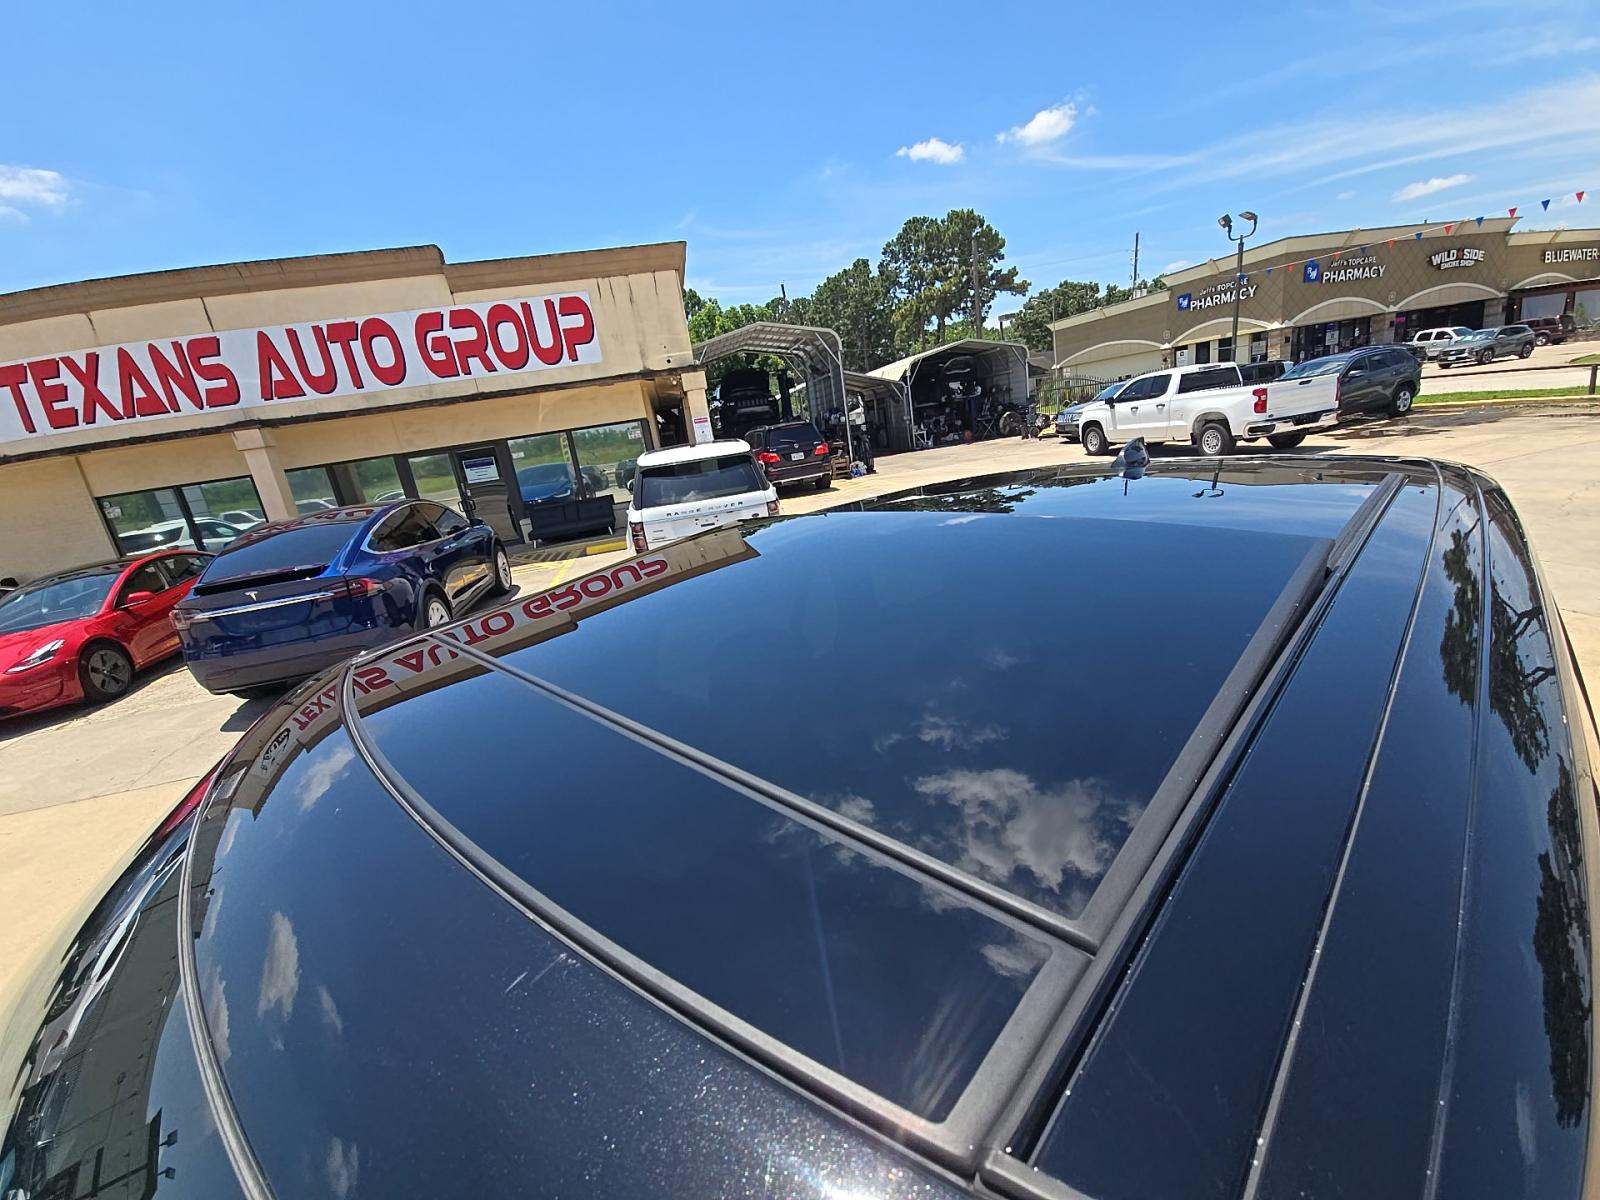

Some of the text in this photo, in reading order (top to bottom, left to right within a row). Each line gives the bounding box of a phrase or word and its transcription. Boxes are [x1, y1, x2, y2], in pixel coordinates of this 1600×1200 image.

[1348, 256, 1377, 266] TOPCARE
[1431, 248, 1486, 266] WILD SIDE
[1544, 248, 1598, 264] BLUEWATER
[1440, 260, 1460, 270] SMOKE
[1322, 265, 1386, 284] PHARMACY
[1217, 277, 1249, 292] TOPCRE
[1190, 285, 1257, 312] PHARMACY
[0, 295, 595, 434] TEXANS AUTO GROUP
